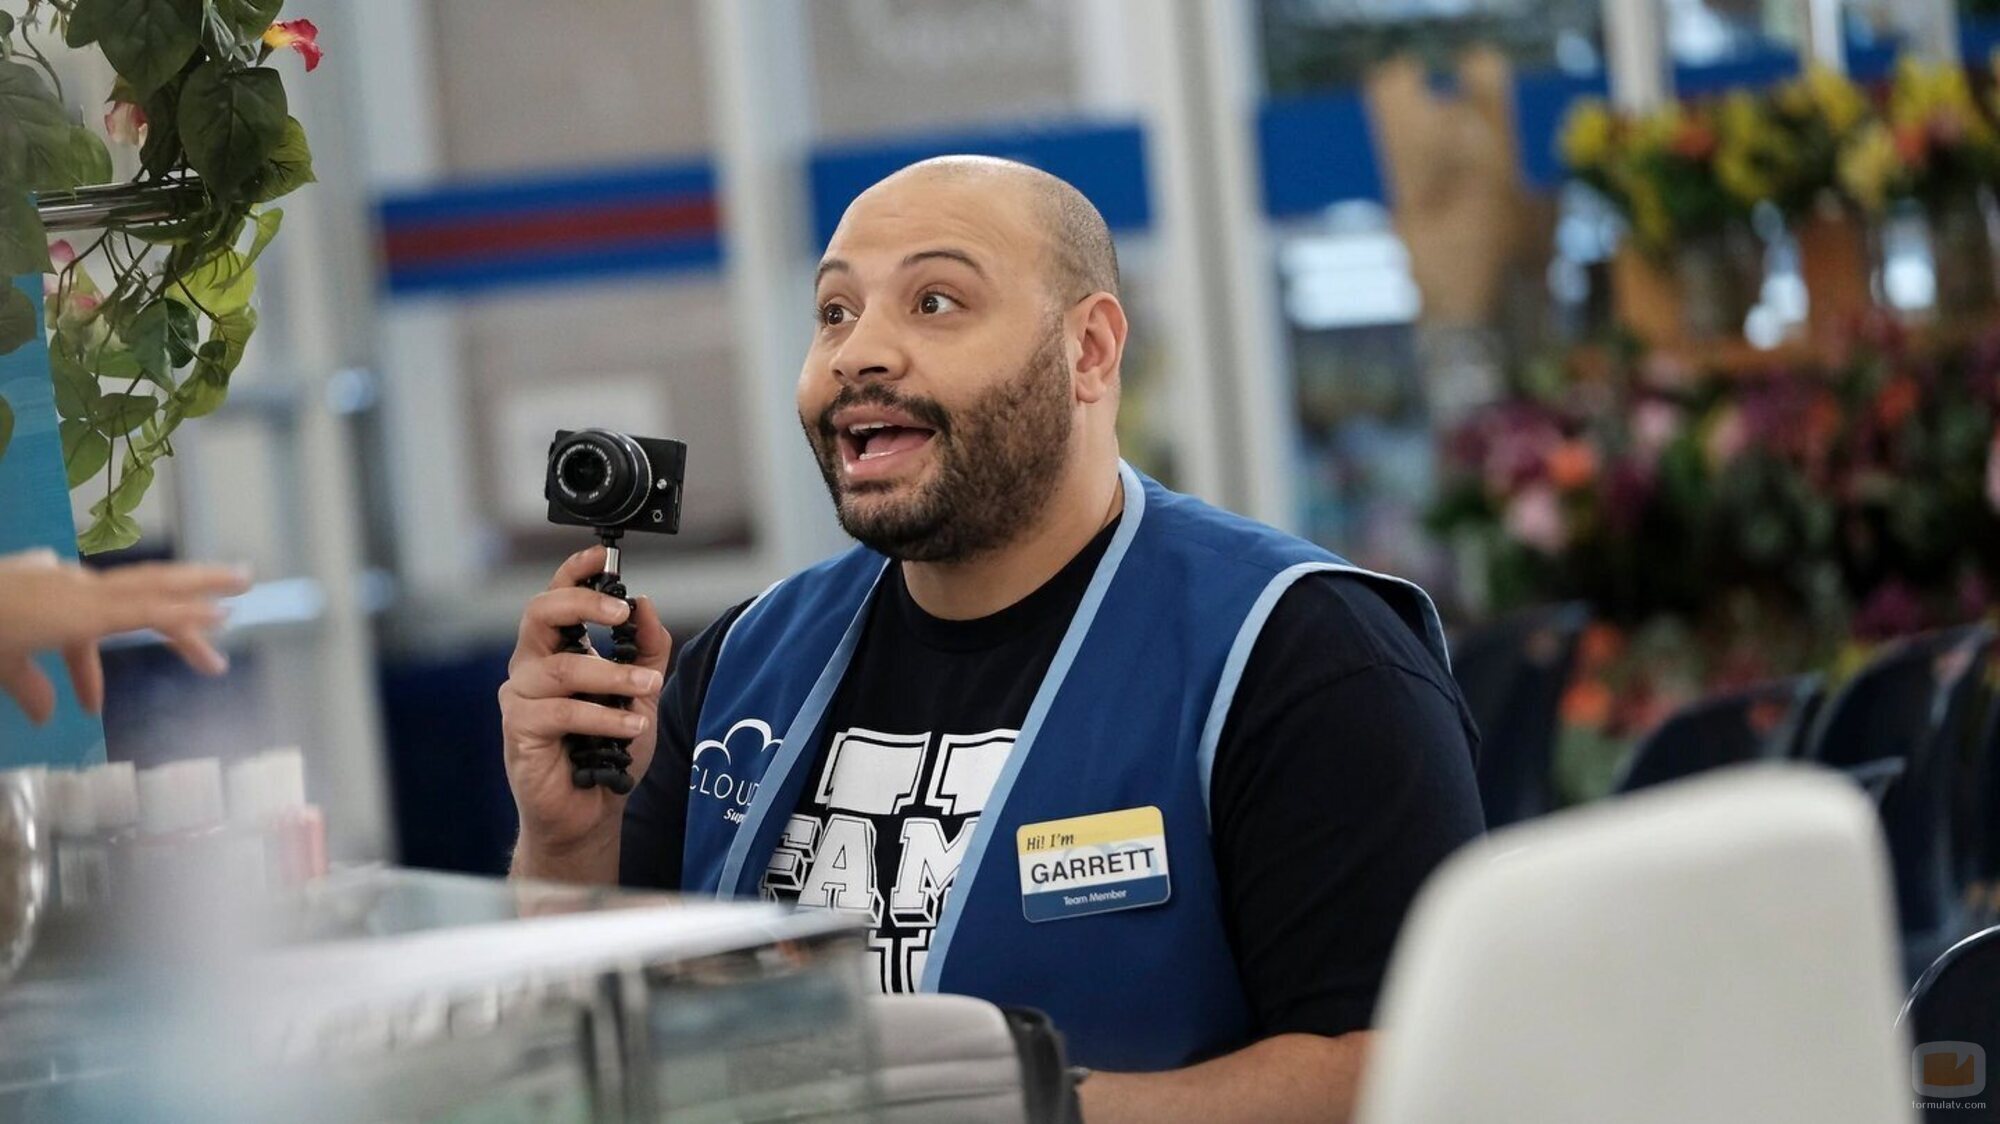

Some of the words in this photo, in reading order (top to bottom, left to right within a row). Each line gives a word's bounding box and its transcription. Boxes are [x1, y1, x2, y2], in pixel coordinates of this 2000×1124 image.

[1027, 836, 1045, 850] Hi!
[1050, 833, 1074, 848] I'm
[1031, 848, 1155, 884] GARRETT
[1063, 896, 1088, 906] Team
[1089, 889, 1127, 902] Member
